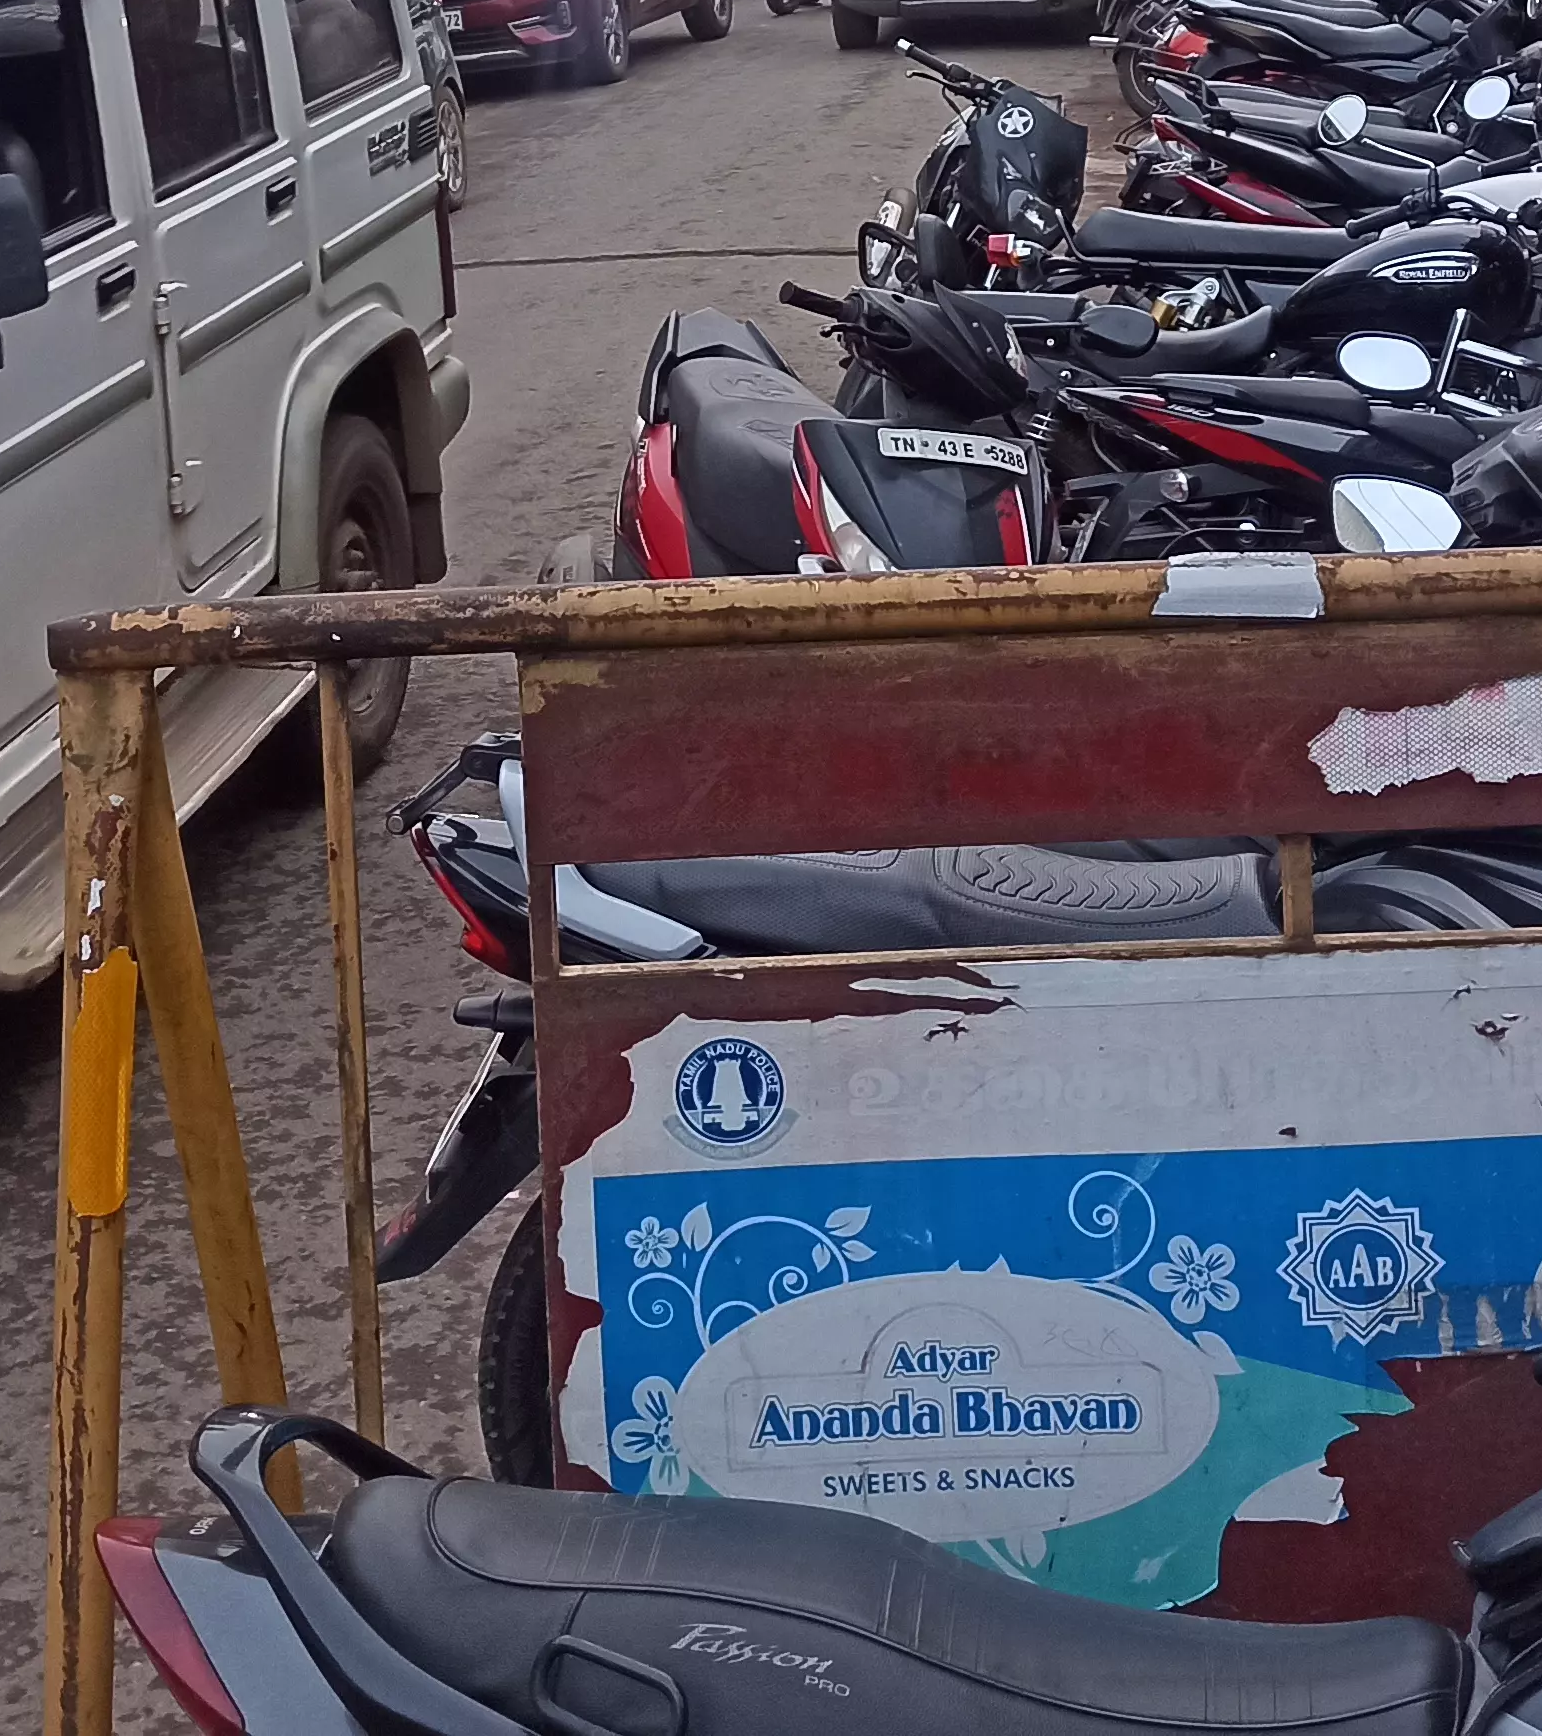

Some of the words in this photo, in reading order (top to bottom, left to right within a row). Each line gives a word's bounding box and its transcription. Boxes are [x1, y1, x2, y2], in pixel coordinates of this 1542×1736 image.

[1399, 270, 1428, 279] ROYAL
[1429, 268, 1465, 278] ENFIELD
[890, 436, 916, 453] TN
[938, 441, 958, 458] 43
[963, 443, 974, 459] E
[989, 447, 1026, 470] 5288
[679, 1058, 705, 1090] TAMIL
[704, 1043, 745, 1058] NADU
[748, 1049, 779, 1093] POLICE
[1328, 1243, 1395, 1292] AAB
[887, 1341, 1000, 1381] Adyar
[749, 1391, 950, 1450] Ananda
[953, 1384, 1144, 1439] Bhavan
[822, 1469, 927, 1499] SWEETS
[936, 1469, 956, 1492] &
[965, 1466, 1076, 1491] SNACKS
[670, 1623, 834, 1676] Passion
[804, 1675, 851, 1697] PRO
